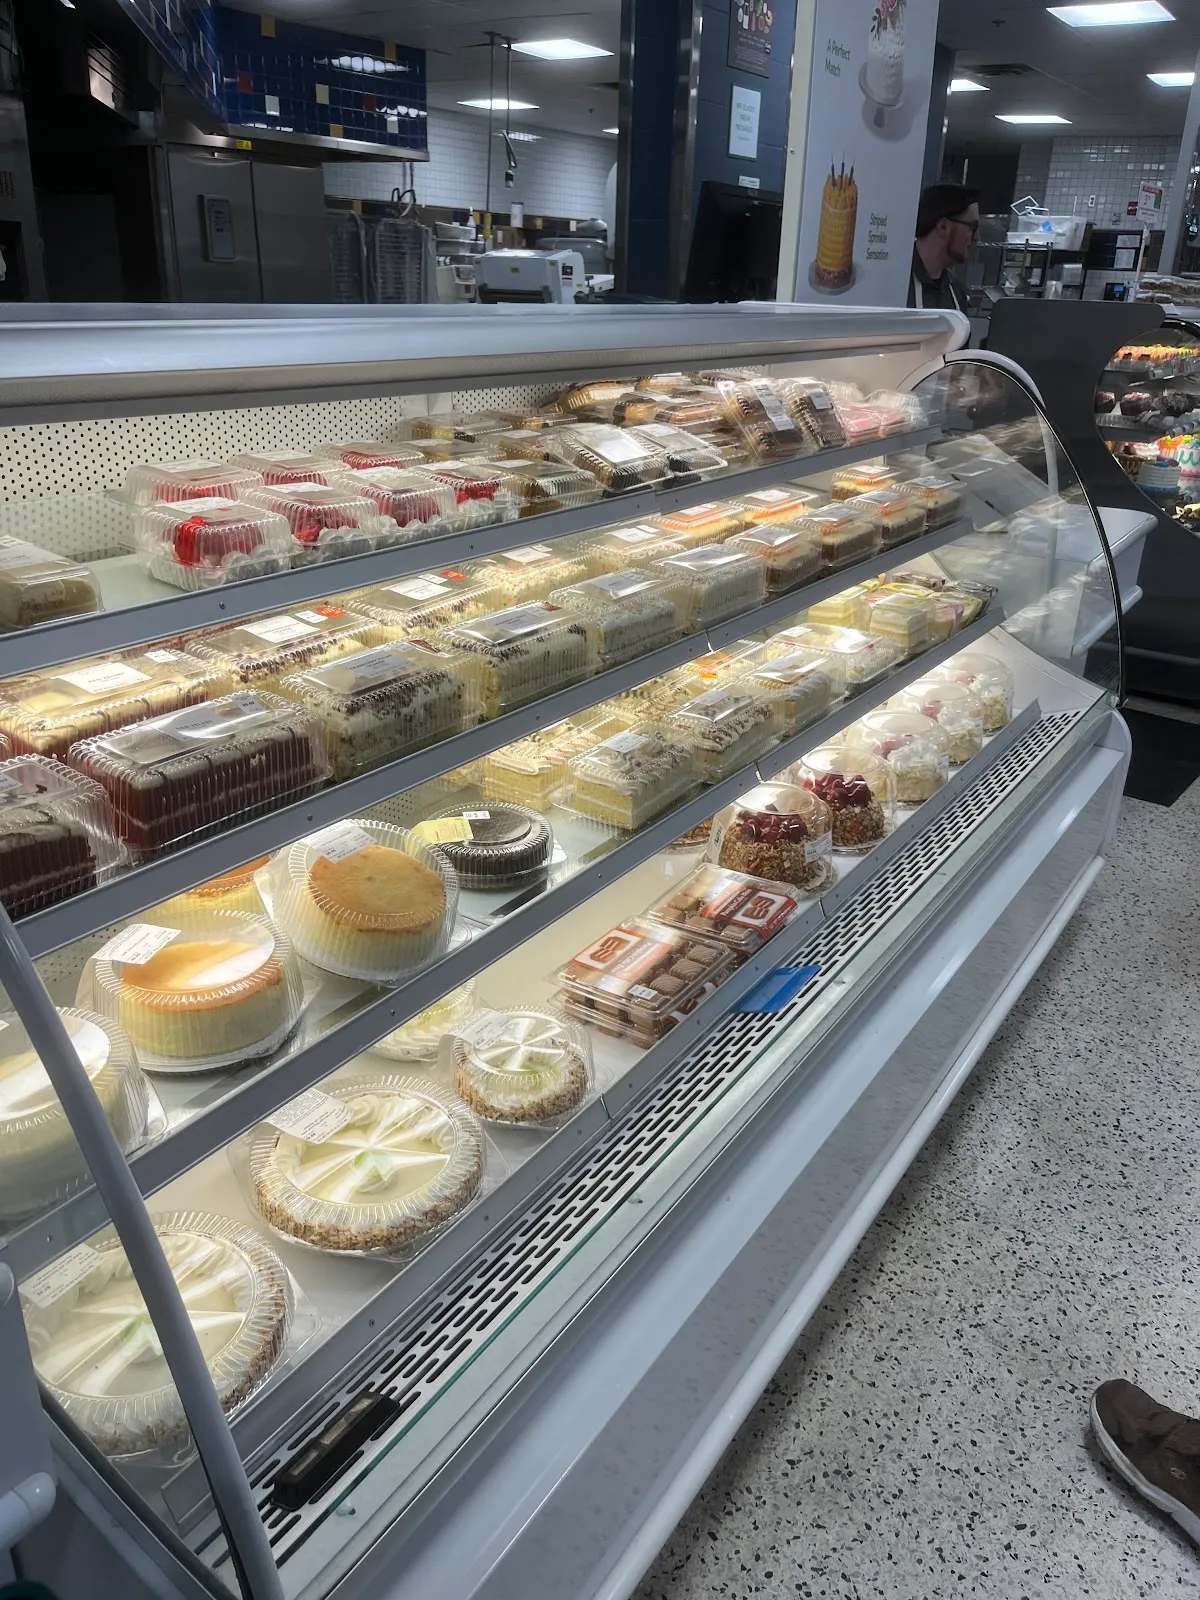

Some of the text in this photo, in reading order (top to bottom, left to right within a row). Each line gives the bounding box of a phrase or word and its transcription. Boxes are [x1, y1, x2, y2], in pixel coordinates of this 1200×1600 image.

[826, 38, 850, 61] A Perfect
[825, 57, 841, 77] Match
[870, 212, 888, 229] Striped
[868, 230, 887, 245] Sprinkle
[866, 247, 889, 260] Sensation
